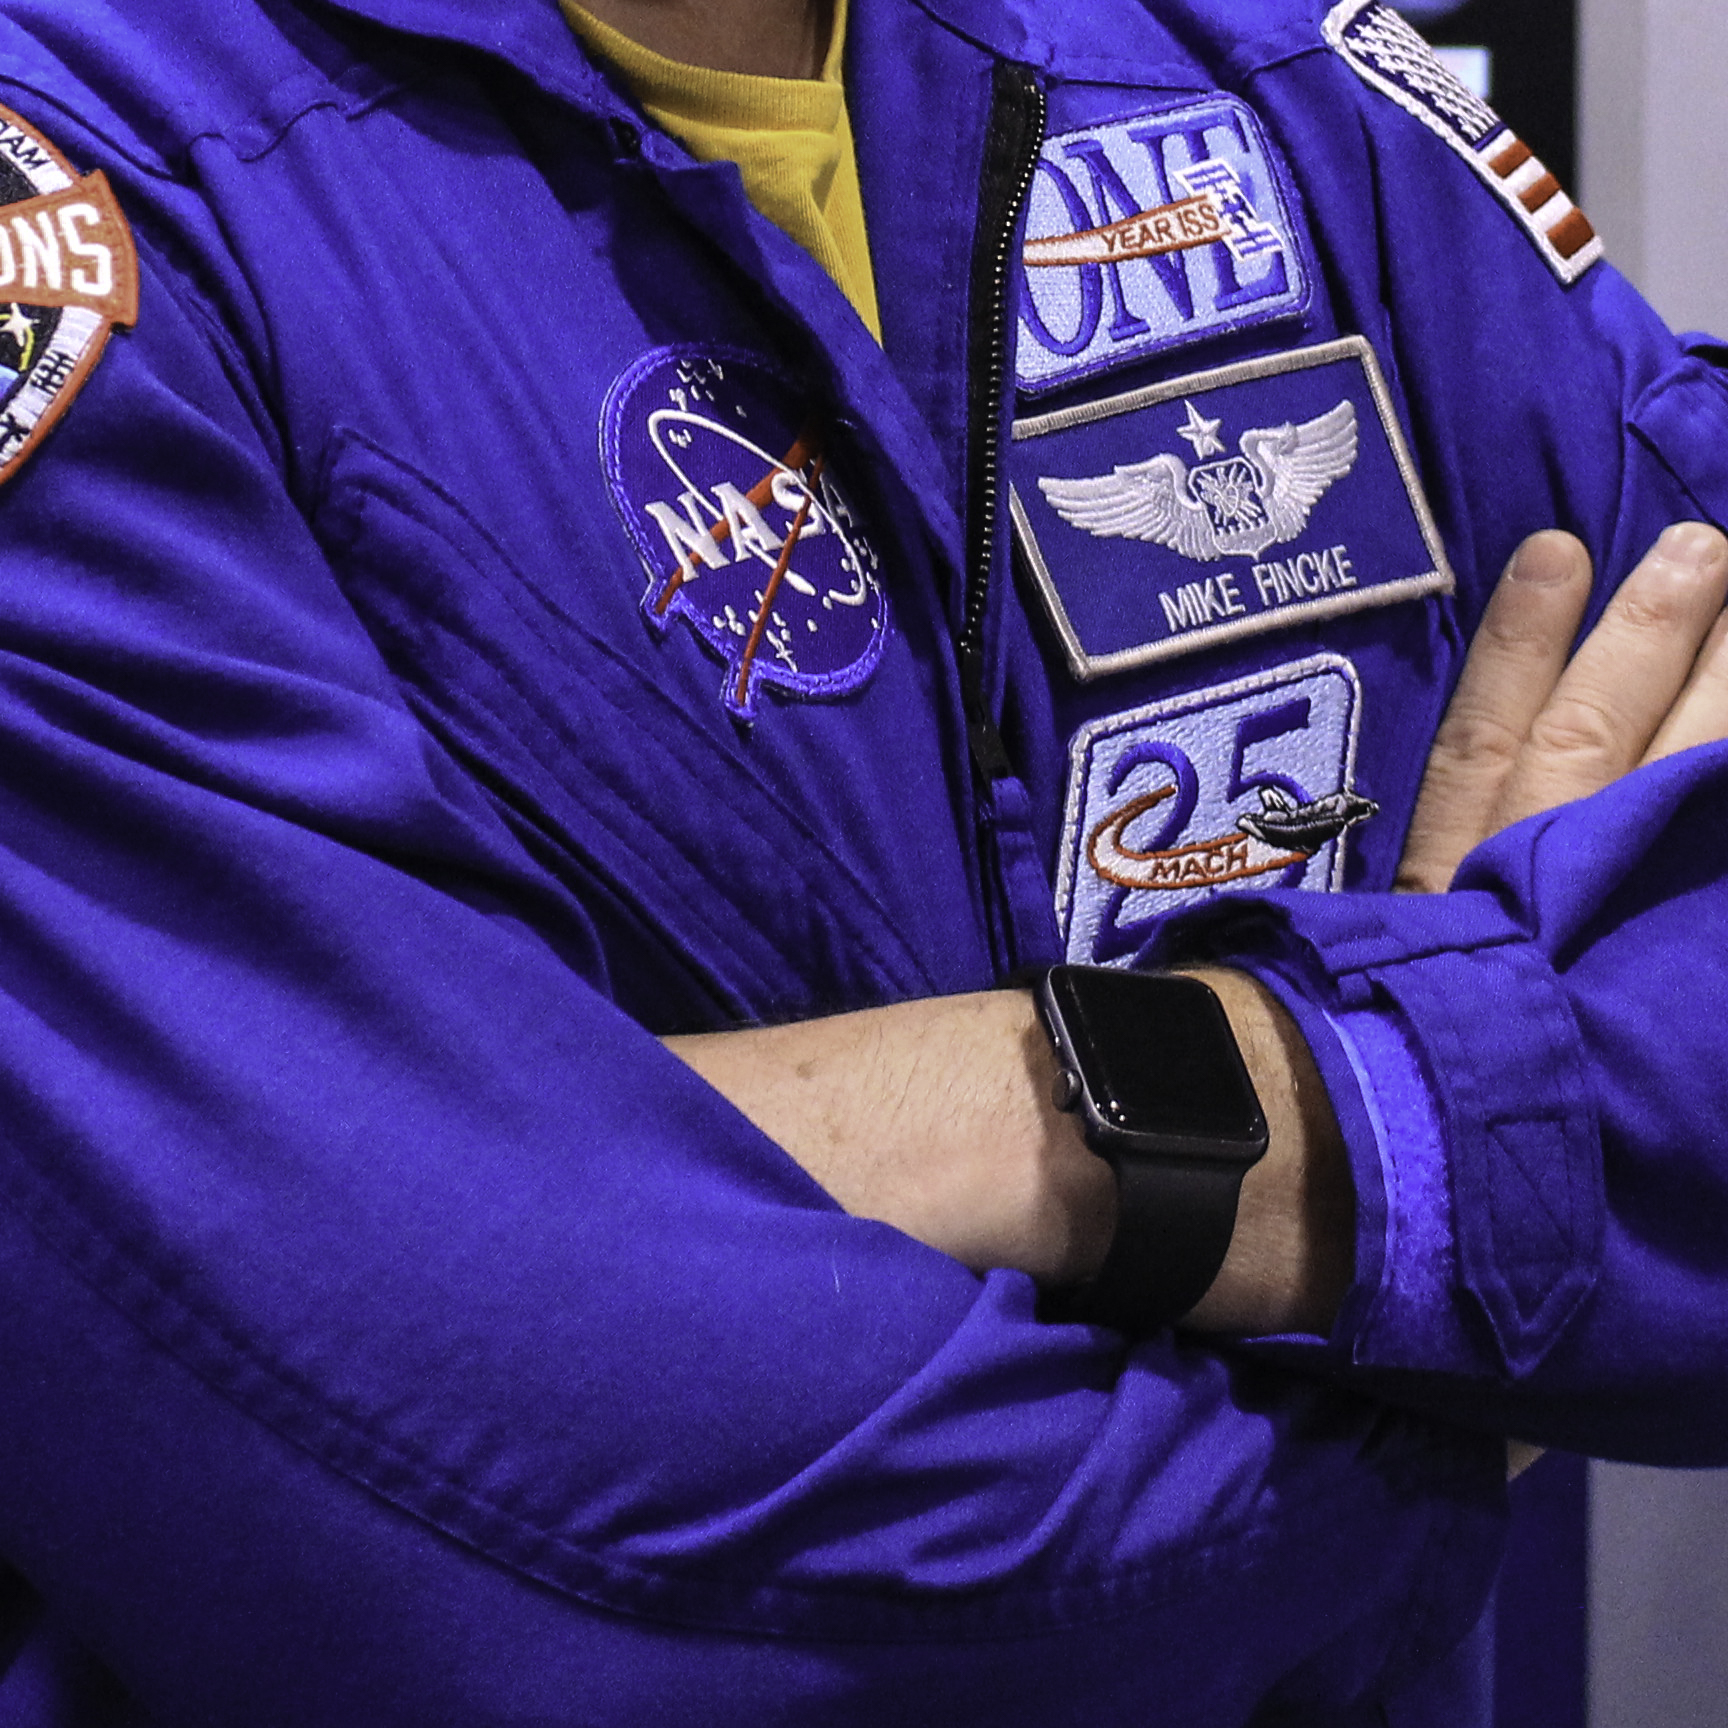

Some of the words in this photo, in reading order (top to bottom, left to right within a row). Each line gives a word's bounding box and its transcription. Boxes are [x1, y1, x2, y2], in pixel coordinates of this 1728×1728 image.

[1016, 110, 1288, 357] ONE
[1100, 212, 1171, 256] YEAR
[1178, 199, 1222, 242] ISS
[644, 458, 855, 584] NASA
[1158, 571, 1247, 633] MIKE
[1251, 544, 1358, 607] FINCKE
[1088, 696, 1316, 964] 25
[1150, 845, 1250, 884] MACH
